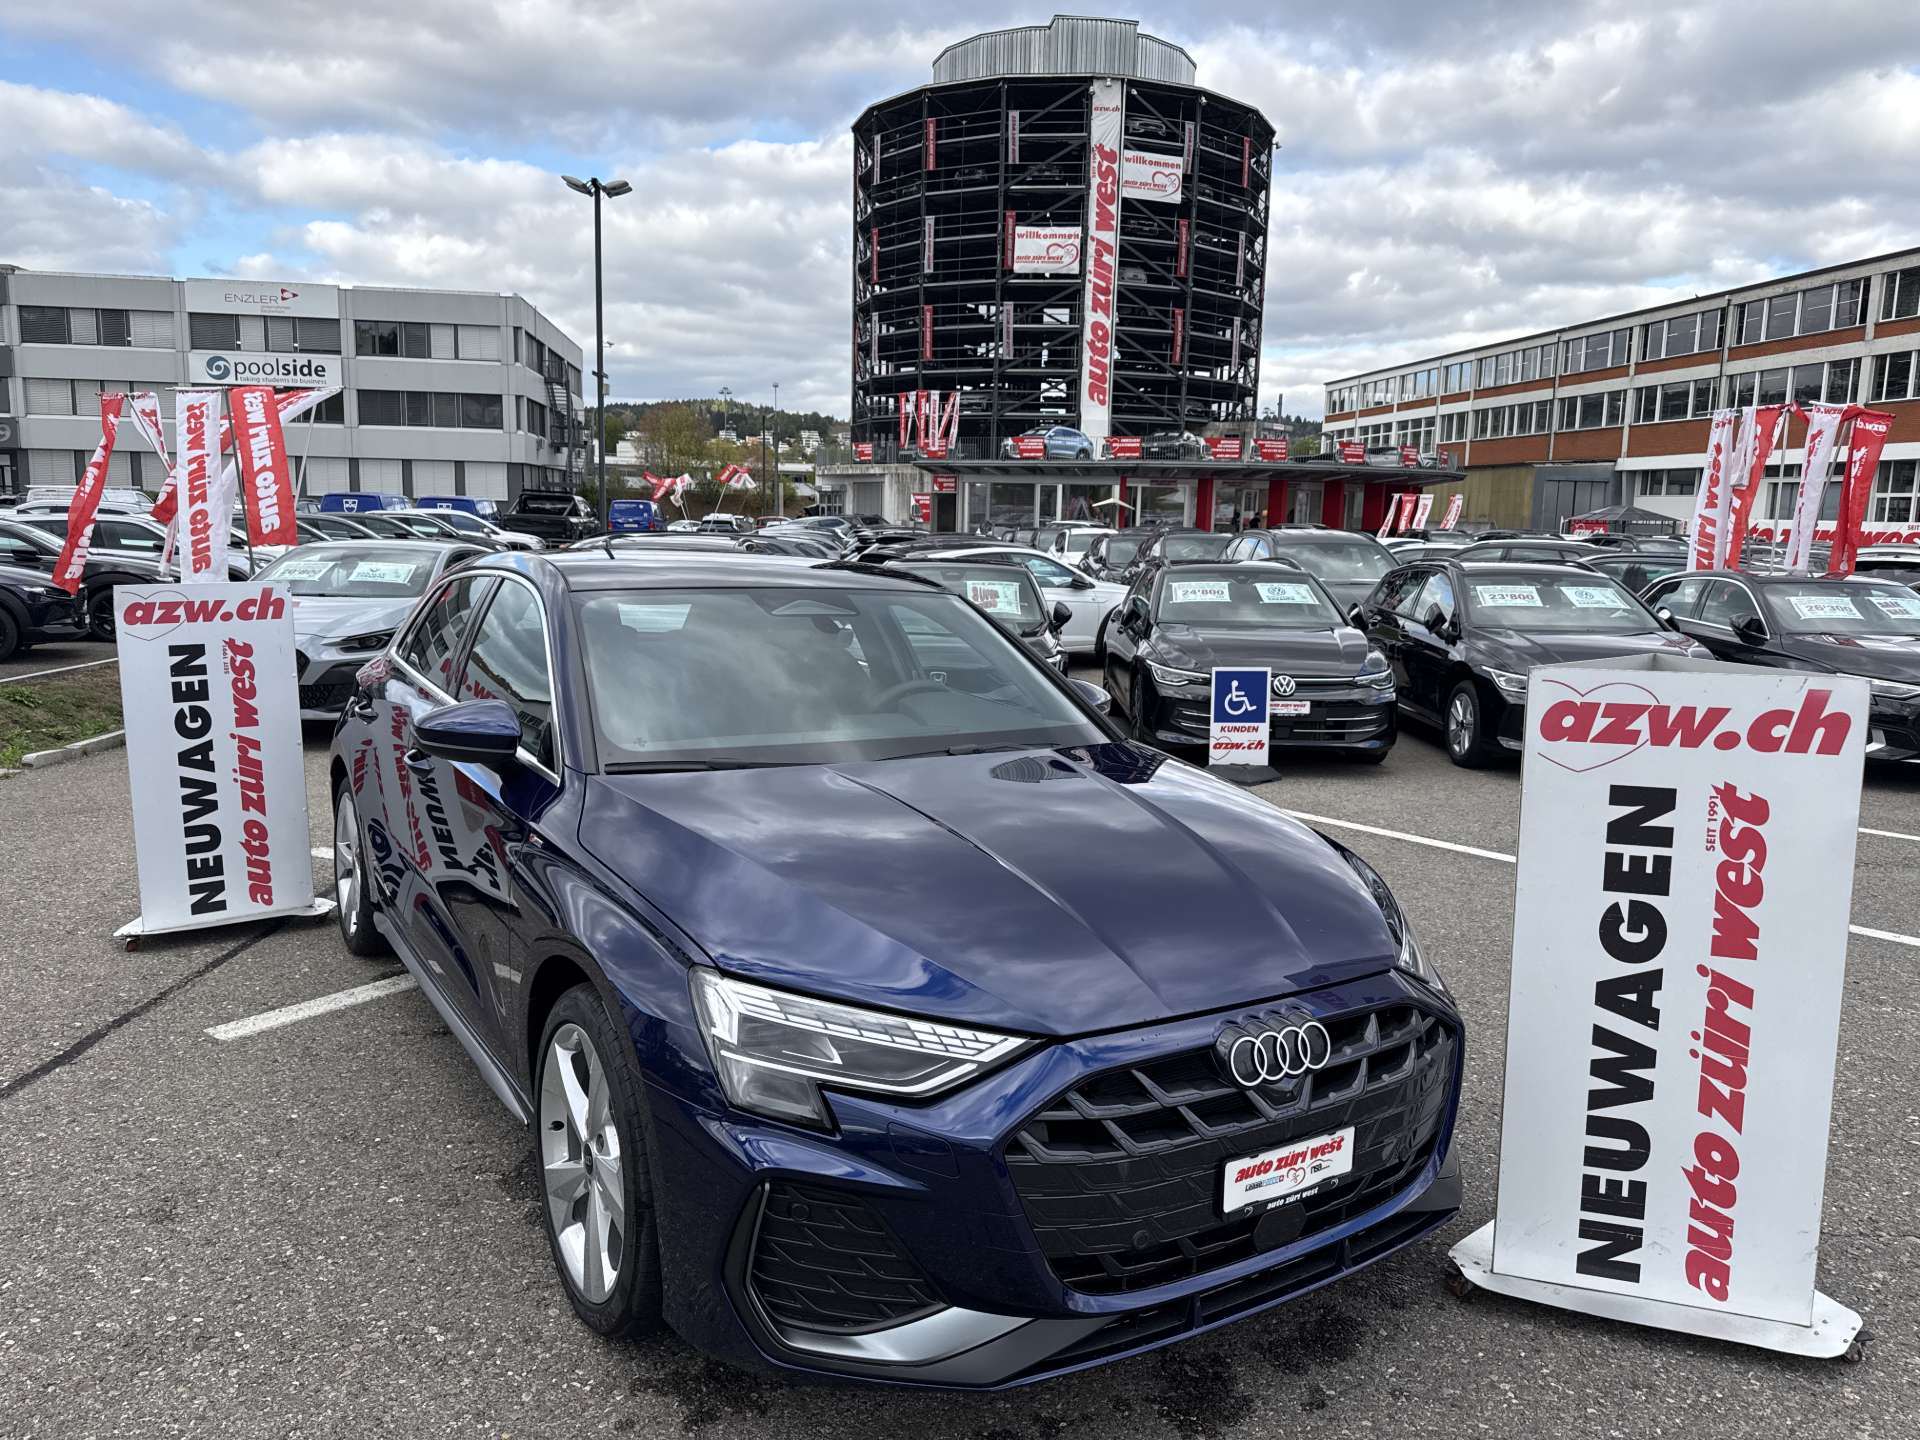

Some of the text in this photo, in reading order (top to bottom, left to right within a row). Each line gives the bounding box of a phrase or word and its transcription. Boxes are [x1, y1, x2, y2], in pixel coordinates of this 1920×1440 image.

[1124, 155, 1181, 170] willkommen
[1016, 230, 1080, 240] willkommen
[1086, 143, 1118, 407] auto züri west
[224, 293, 279, 304] ENZLER
[234, 358, 327, 382] poolside
[239, 376, 260, 384] taking
[262, 376, 290, 384] students
[299, 378, 327, 386] business
[123, 587, 285, 626] azw.ch
[1487, 593, 1535, 601] 23'800
[1220, 725, 1259, 733] KUNDEN
[1540, 689, 1852, 756] azw.ch
[1212, 739, 1266, 751] azw.ch
[168, 643, 227, 916] NEUWAGEN
[222, 637, 273, 906] auto züri west
[1705, 795, 1719, 852] SEIT 1991
[1576, 784, 1677, 1284] NEUWAGEN
[1680, 780, 1770, 1302] auto züri west
[1234, 1134, 1345, 1184] auto züri west
[1266, 1187, 1319, 1210] auto züri west
